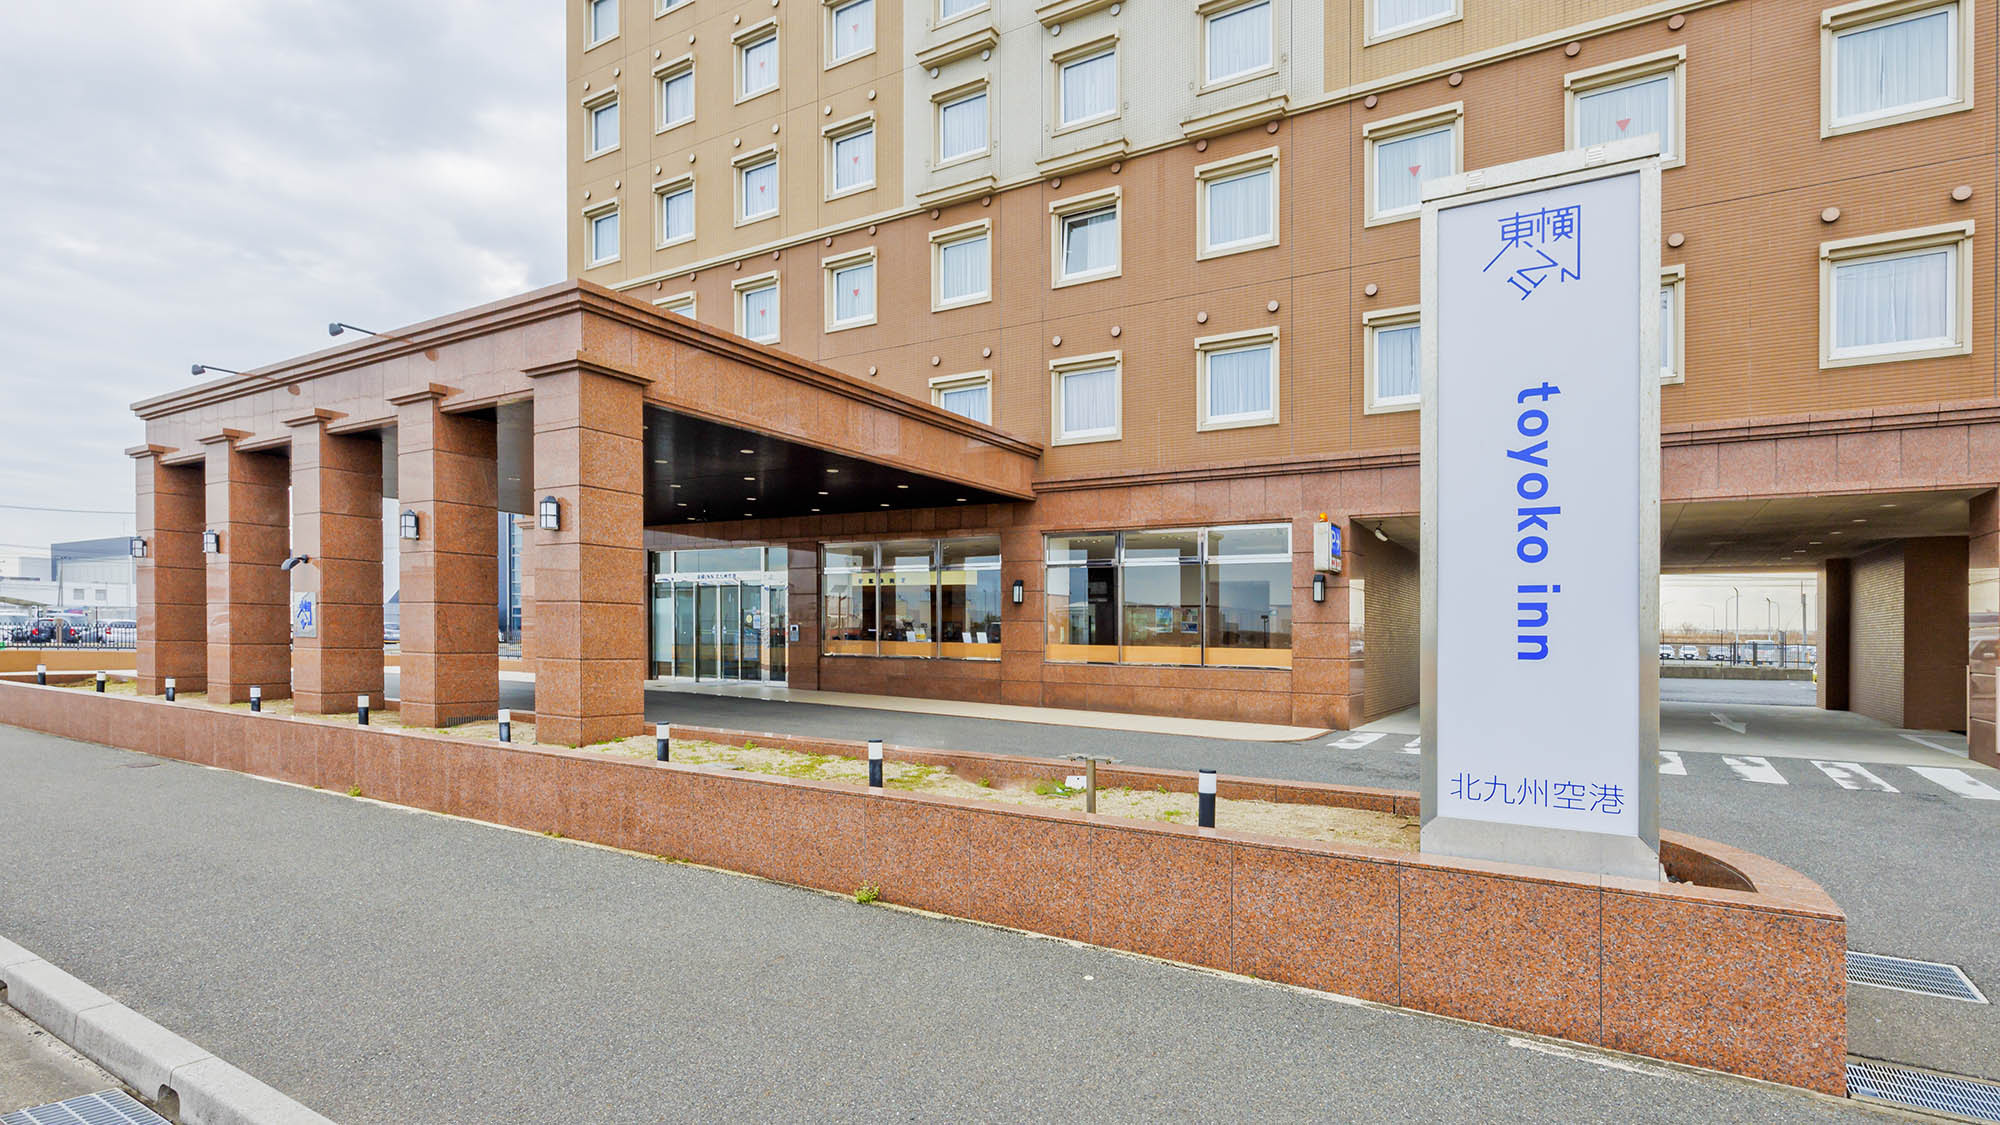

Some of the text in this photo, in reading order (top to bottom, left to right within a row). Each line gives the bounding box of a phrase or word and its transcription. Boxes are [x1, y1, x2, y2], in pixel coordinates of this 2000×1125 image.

[1507, 381, 1561, 661] toyoko inn
[1450, 772, 1625, 815] 北九州空港
